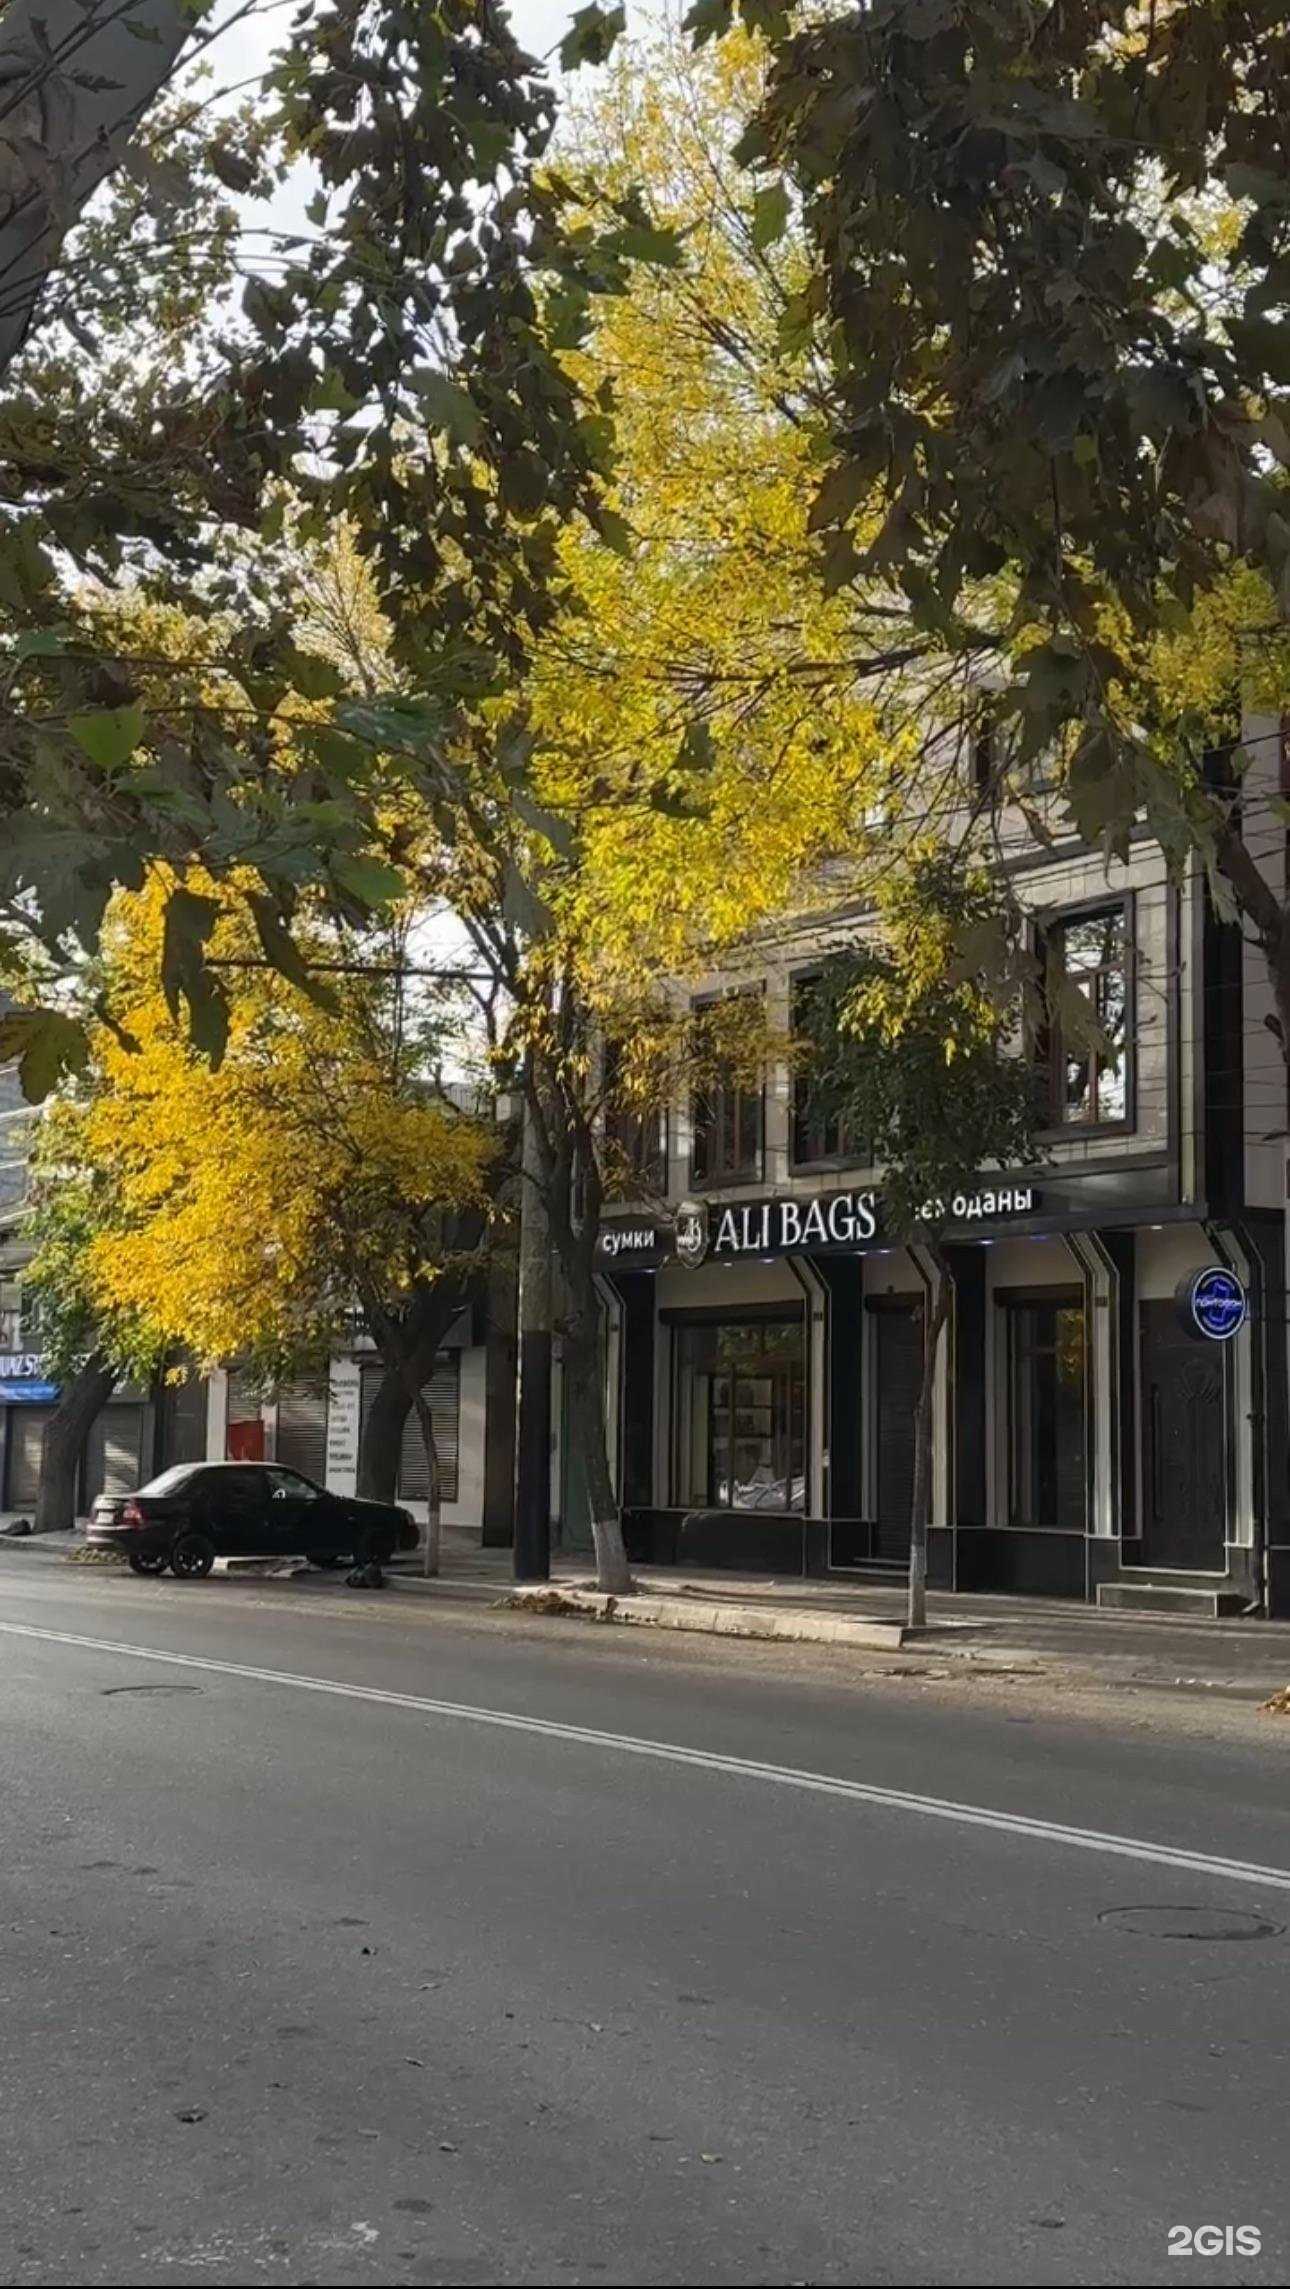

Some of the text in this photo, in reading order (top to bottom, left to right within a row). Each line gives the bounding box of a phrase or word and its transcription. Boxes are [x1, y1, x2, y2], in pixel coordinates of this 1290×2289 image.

[714, 1191, 876, 1251] ALI BAGS
[907, 1188, 1033, 1221] еоданы
[602, 1229, 655, 1255] сумки
